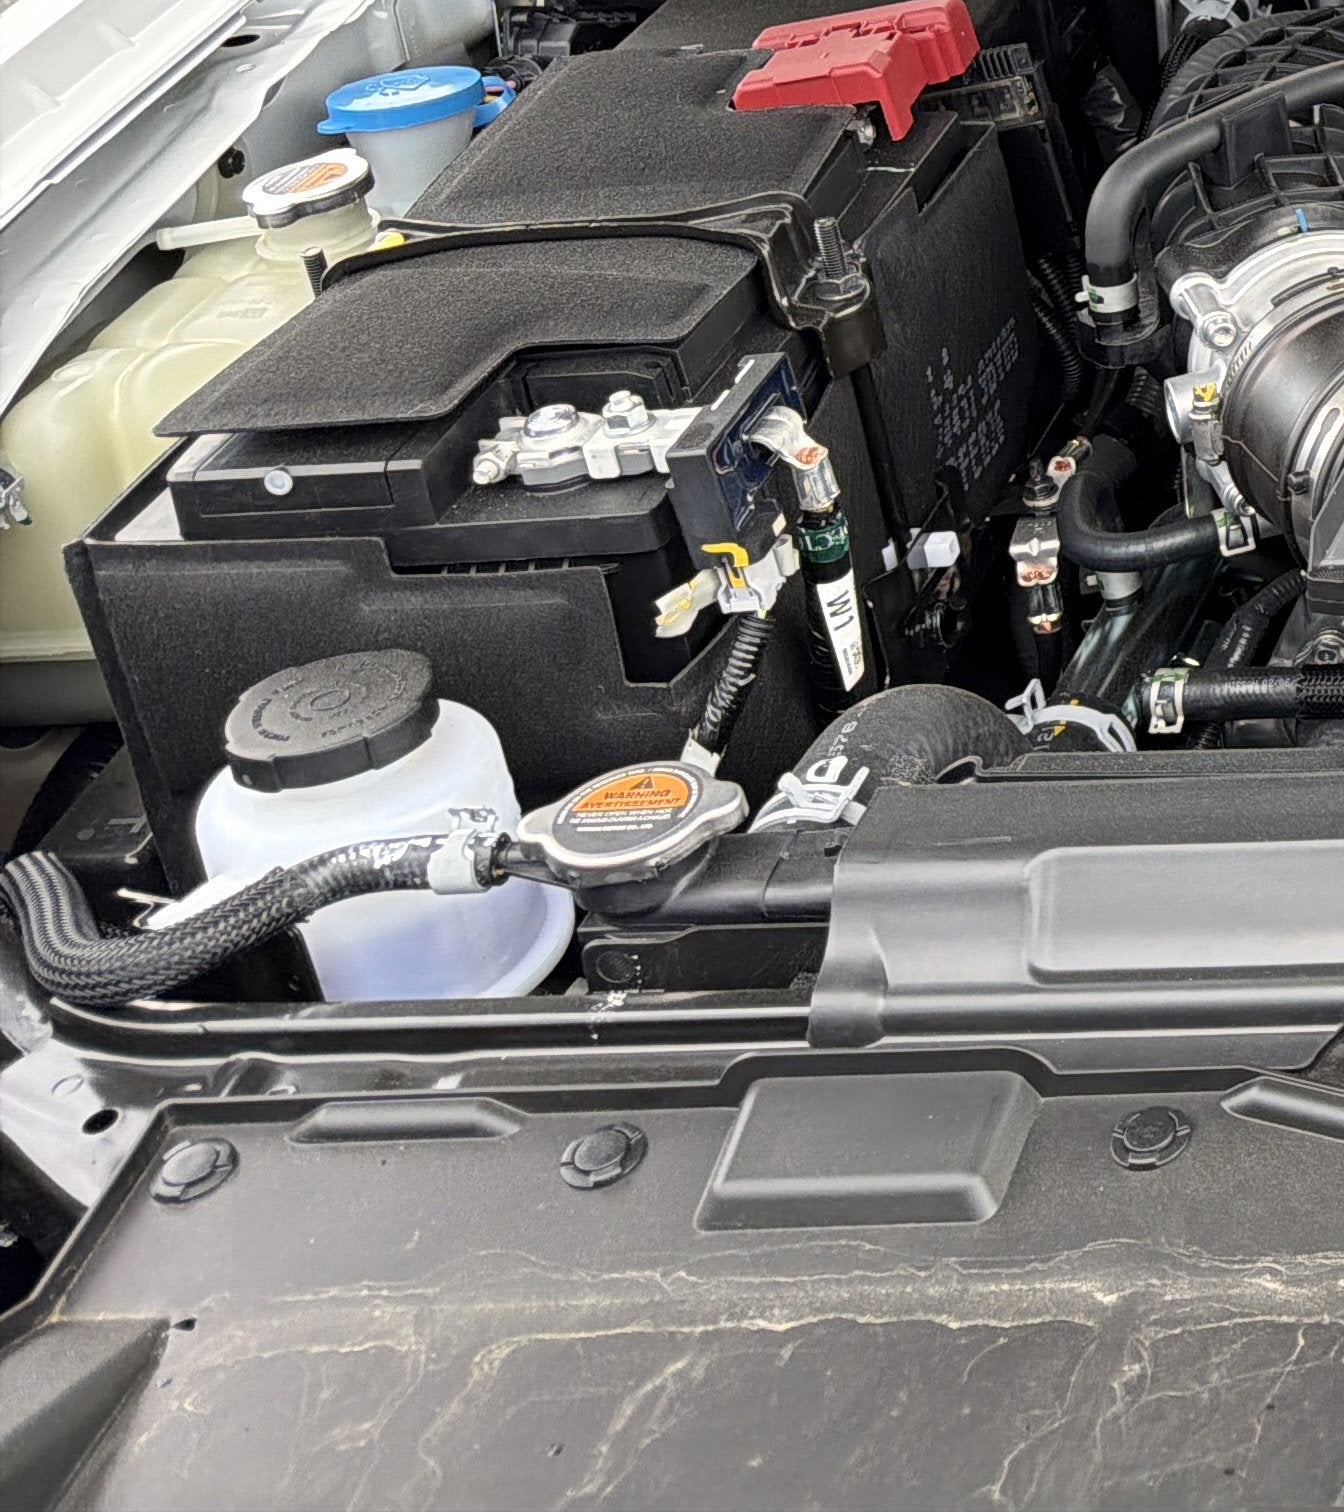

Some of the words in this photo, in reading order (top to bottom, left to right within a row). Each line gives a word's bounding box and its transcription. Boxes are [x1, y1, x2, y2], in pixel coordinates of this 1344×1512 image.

[827, 589, 855, 632] W1
[605, 790, 671, 800] WARNING
[581, 798, 681, 809] AVERTISSEMENT
